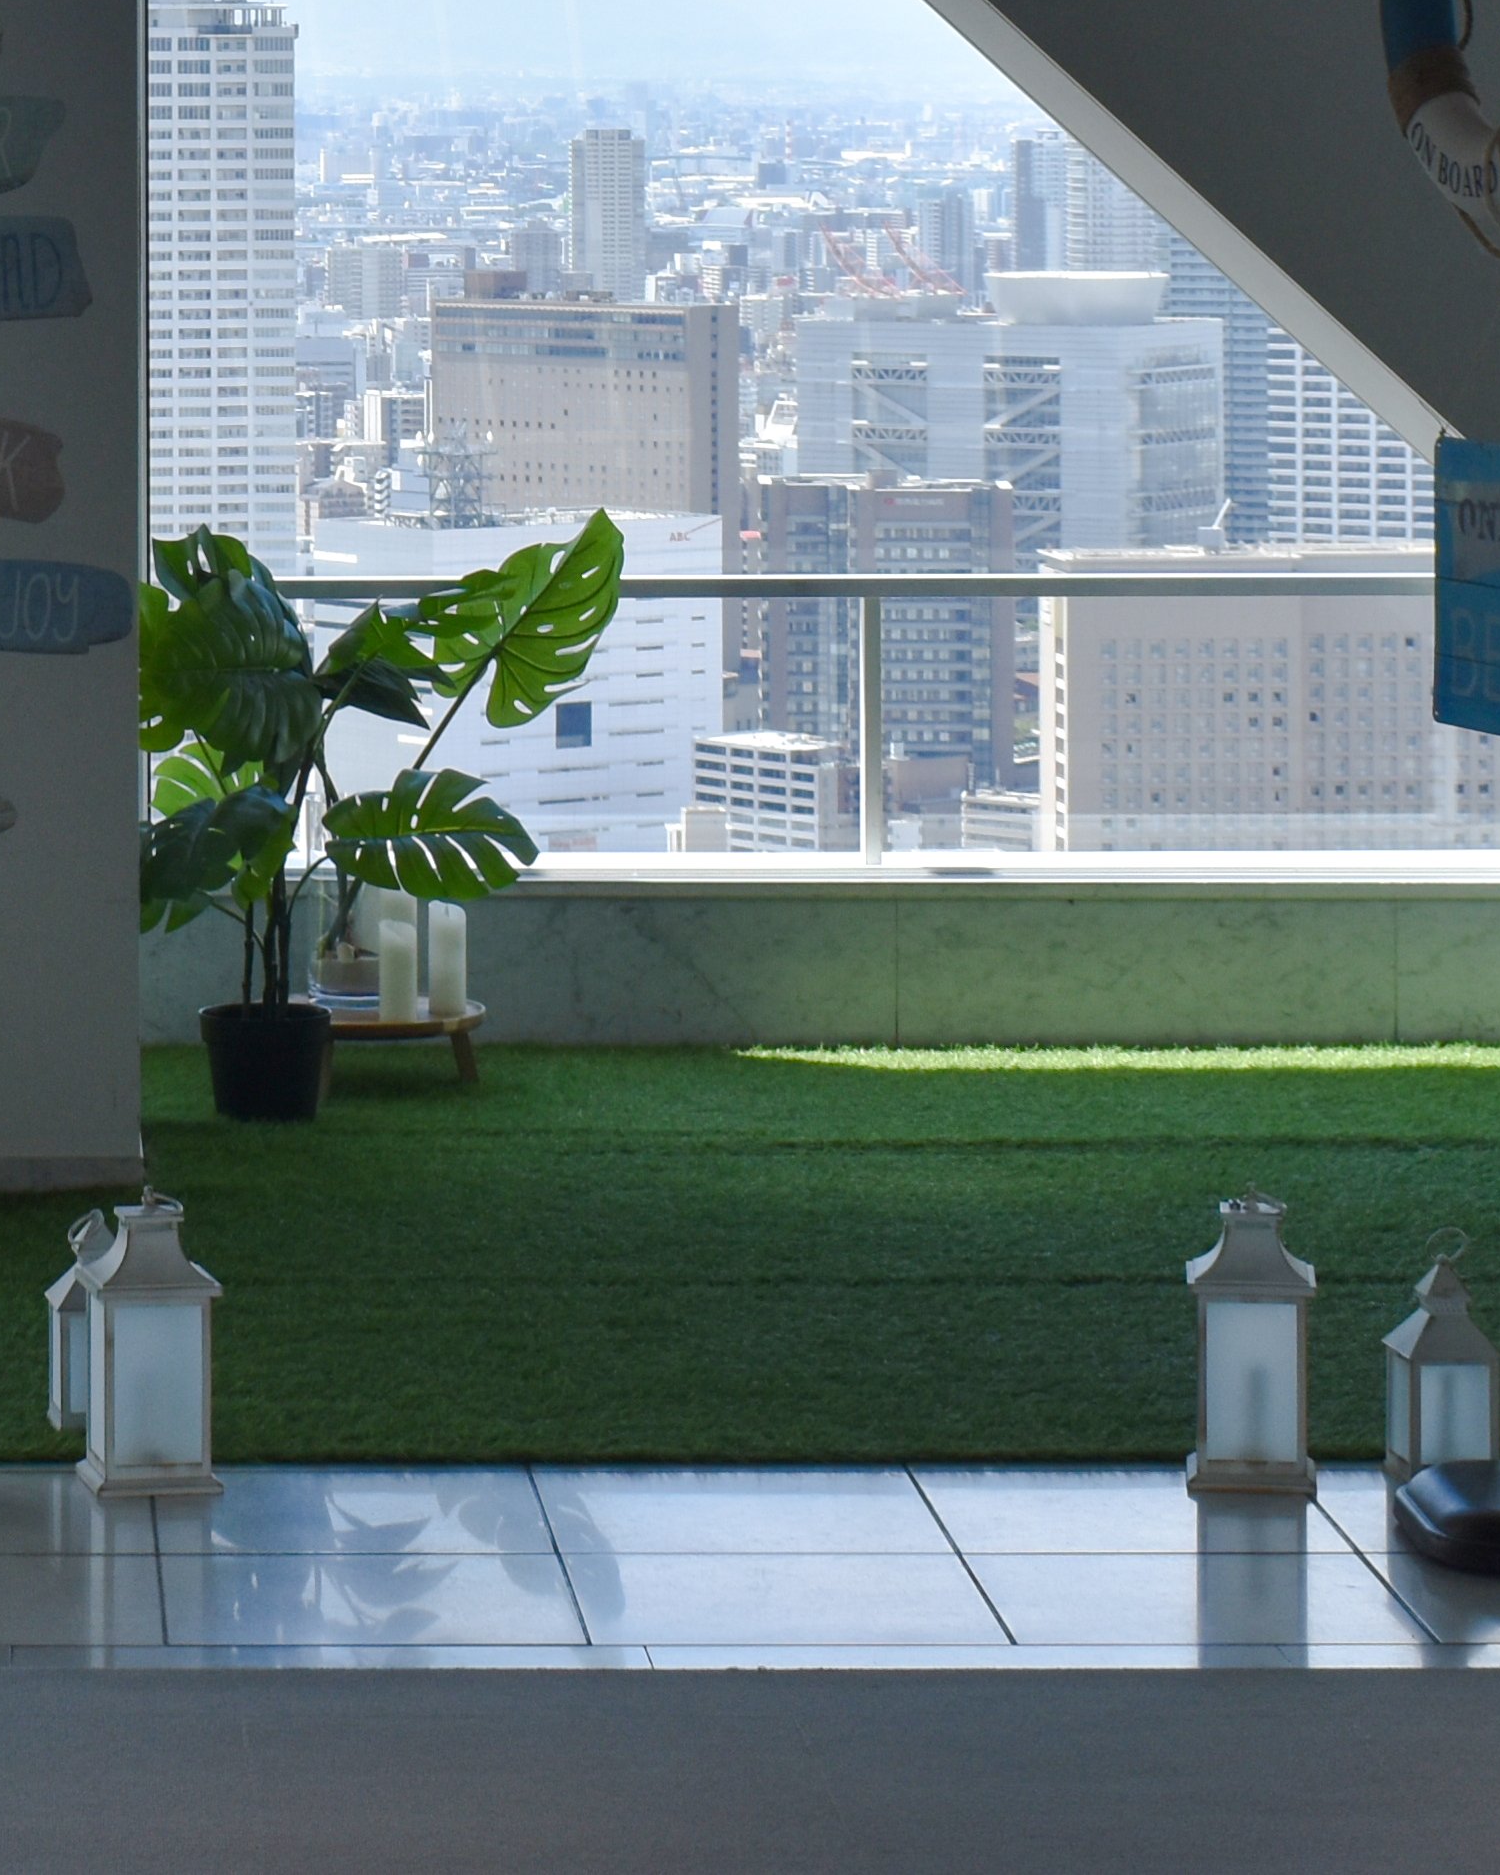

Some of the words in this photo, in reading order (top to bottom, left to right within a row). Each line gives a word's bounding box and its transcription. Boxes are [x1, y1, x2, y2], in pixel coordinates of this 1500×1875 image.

[1410, 122, 1437, 171] ON
[1438, 151, 1498, 198] BOARD
[669, 531, 691, 542] ABC
